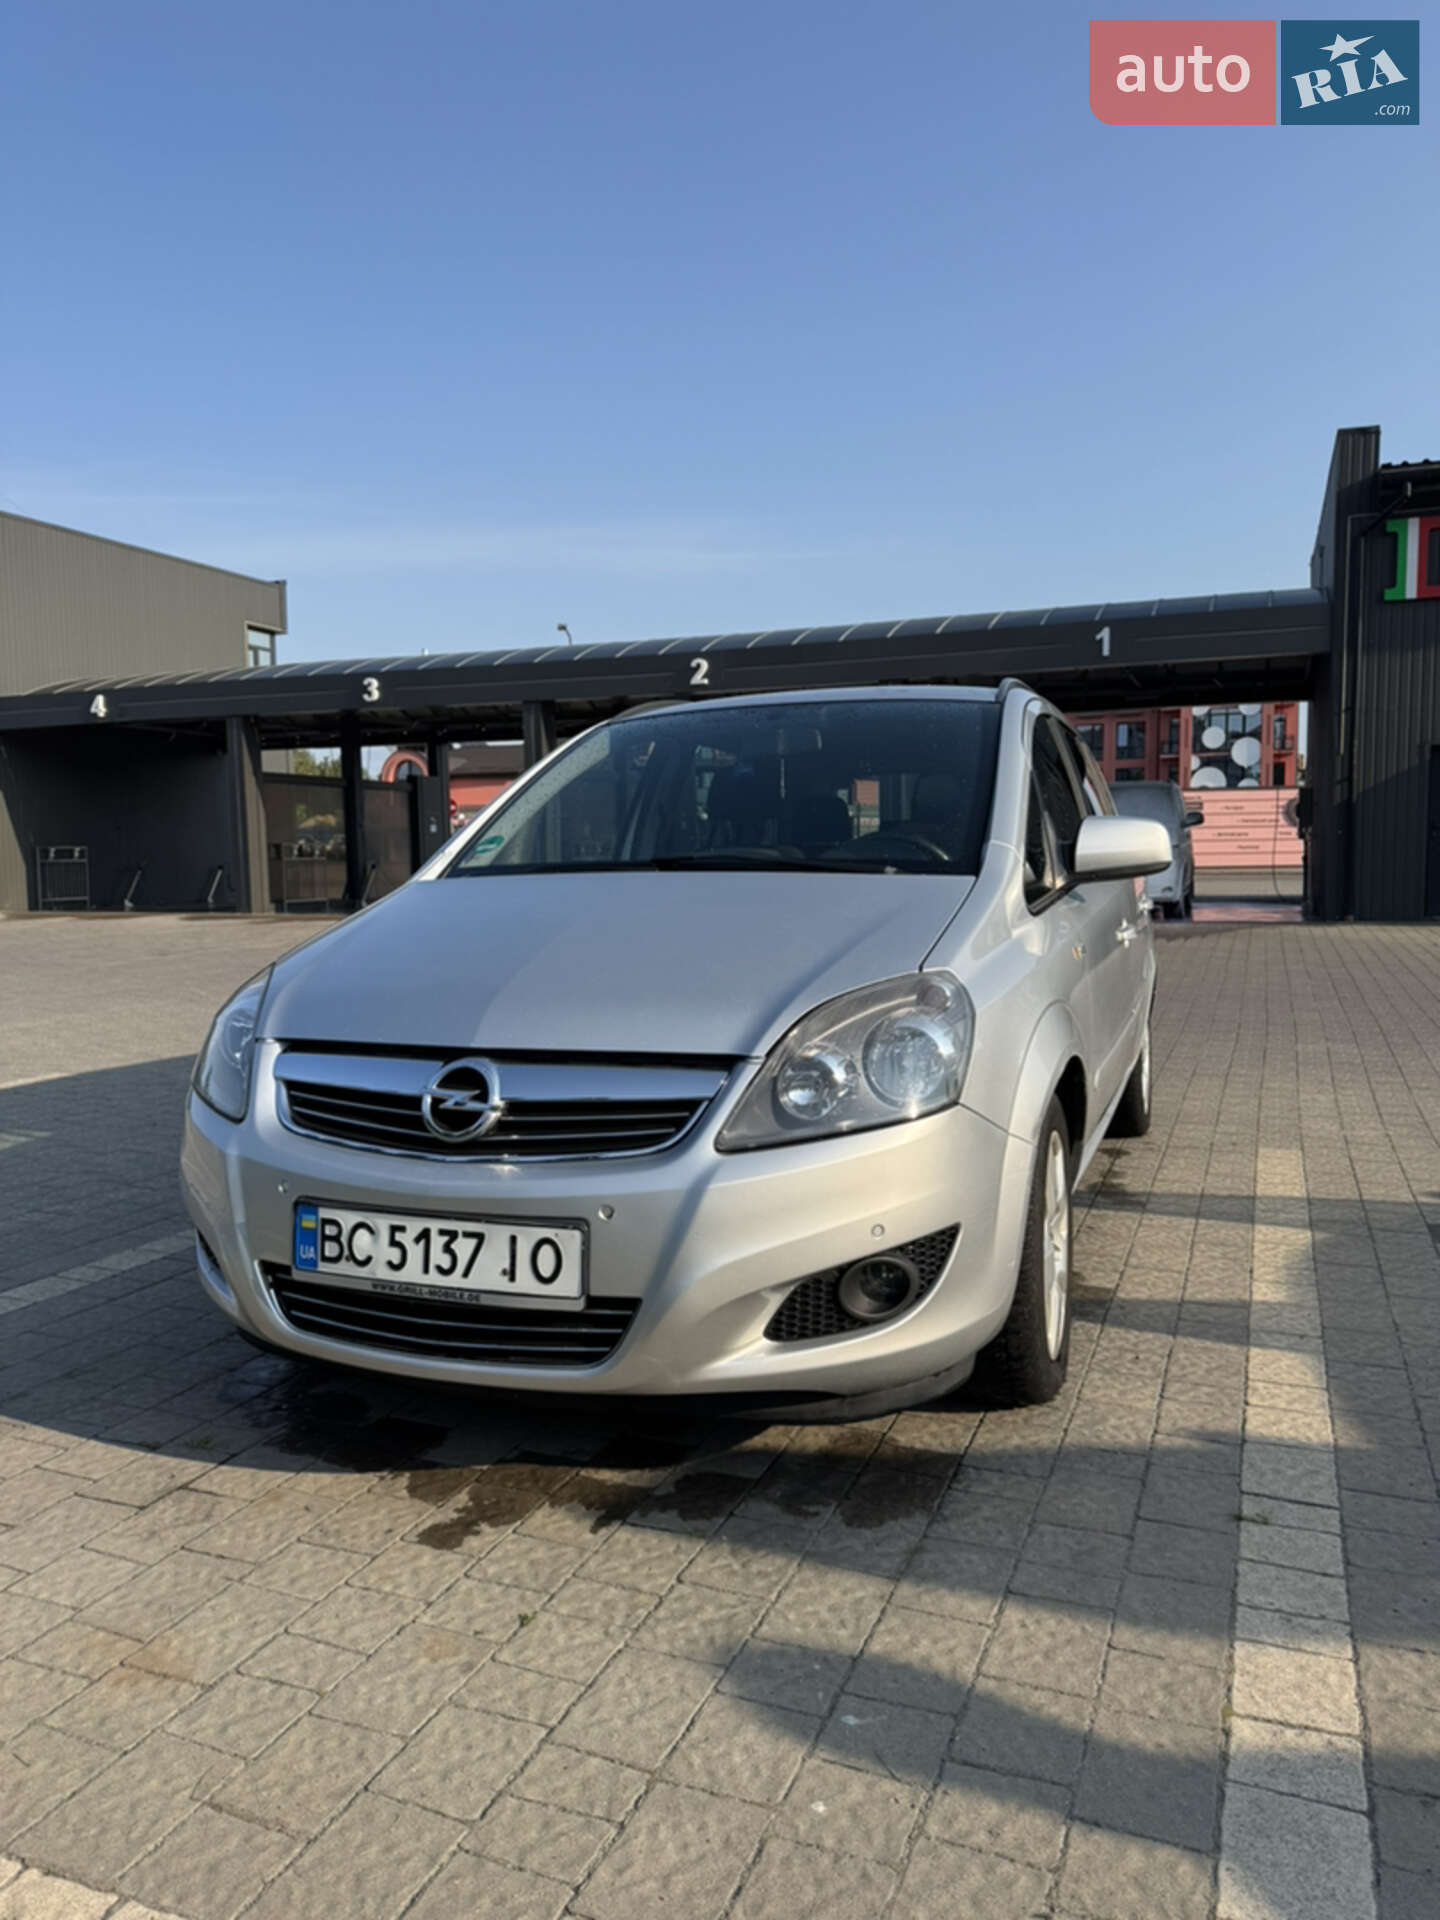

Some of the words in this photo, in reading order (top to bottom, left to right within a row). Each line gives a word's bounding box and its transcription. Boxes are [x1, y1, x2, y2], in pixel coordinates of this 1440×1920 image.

[1095, 626, 1111, 657] 1
[690, 657, 709, 685] 2
[362, 677, 380, 702] 3
[90, 694, 107, 717] 4
[300, 1244, 316, 1260] UA
[320, 1217, 375, 1268] BC
[386, 1224, 486, 1279] 5137
[508, 1234, 563, 1285] IO
